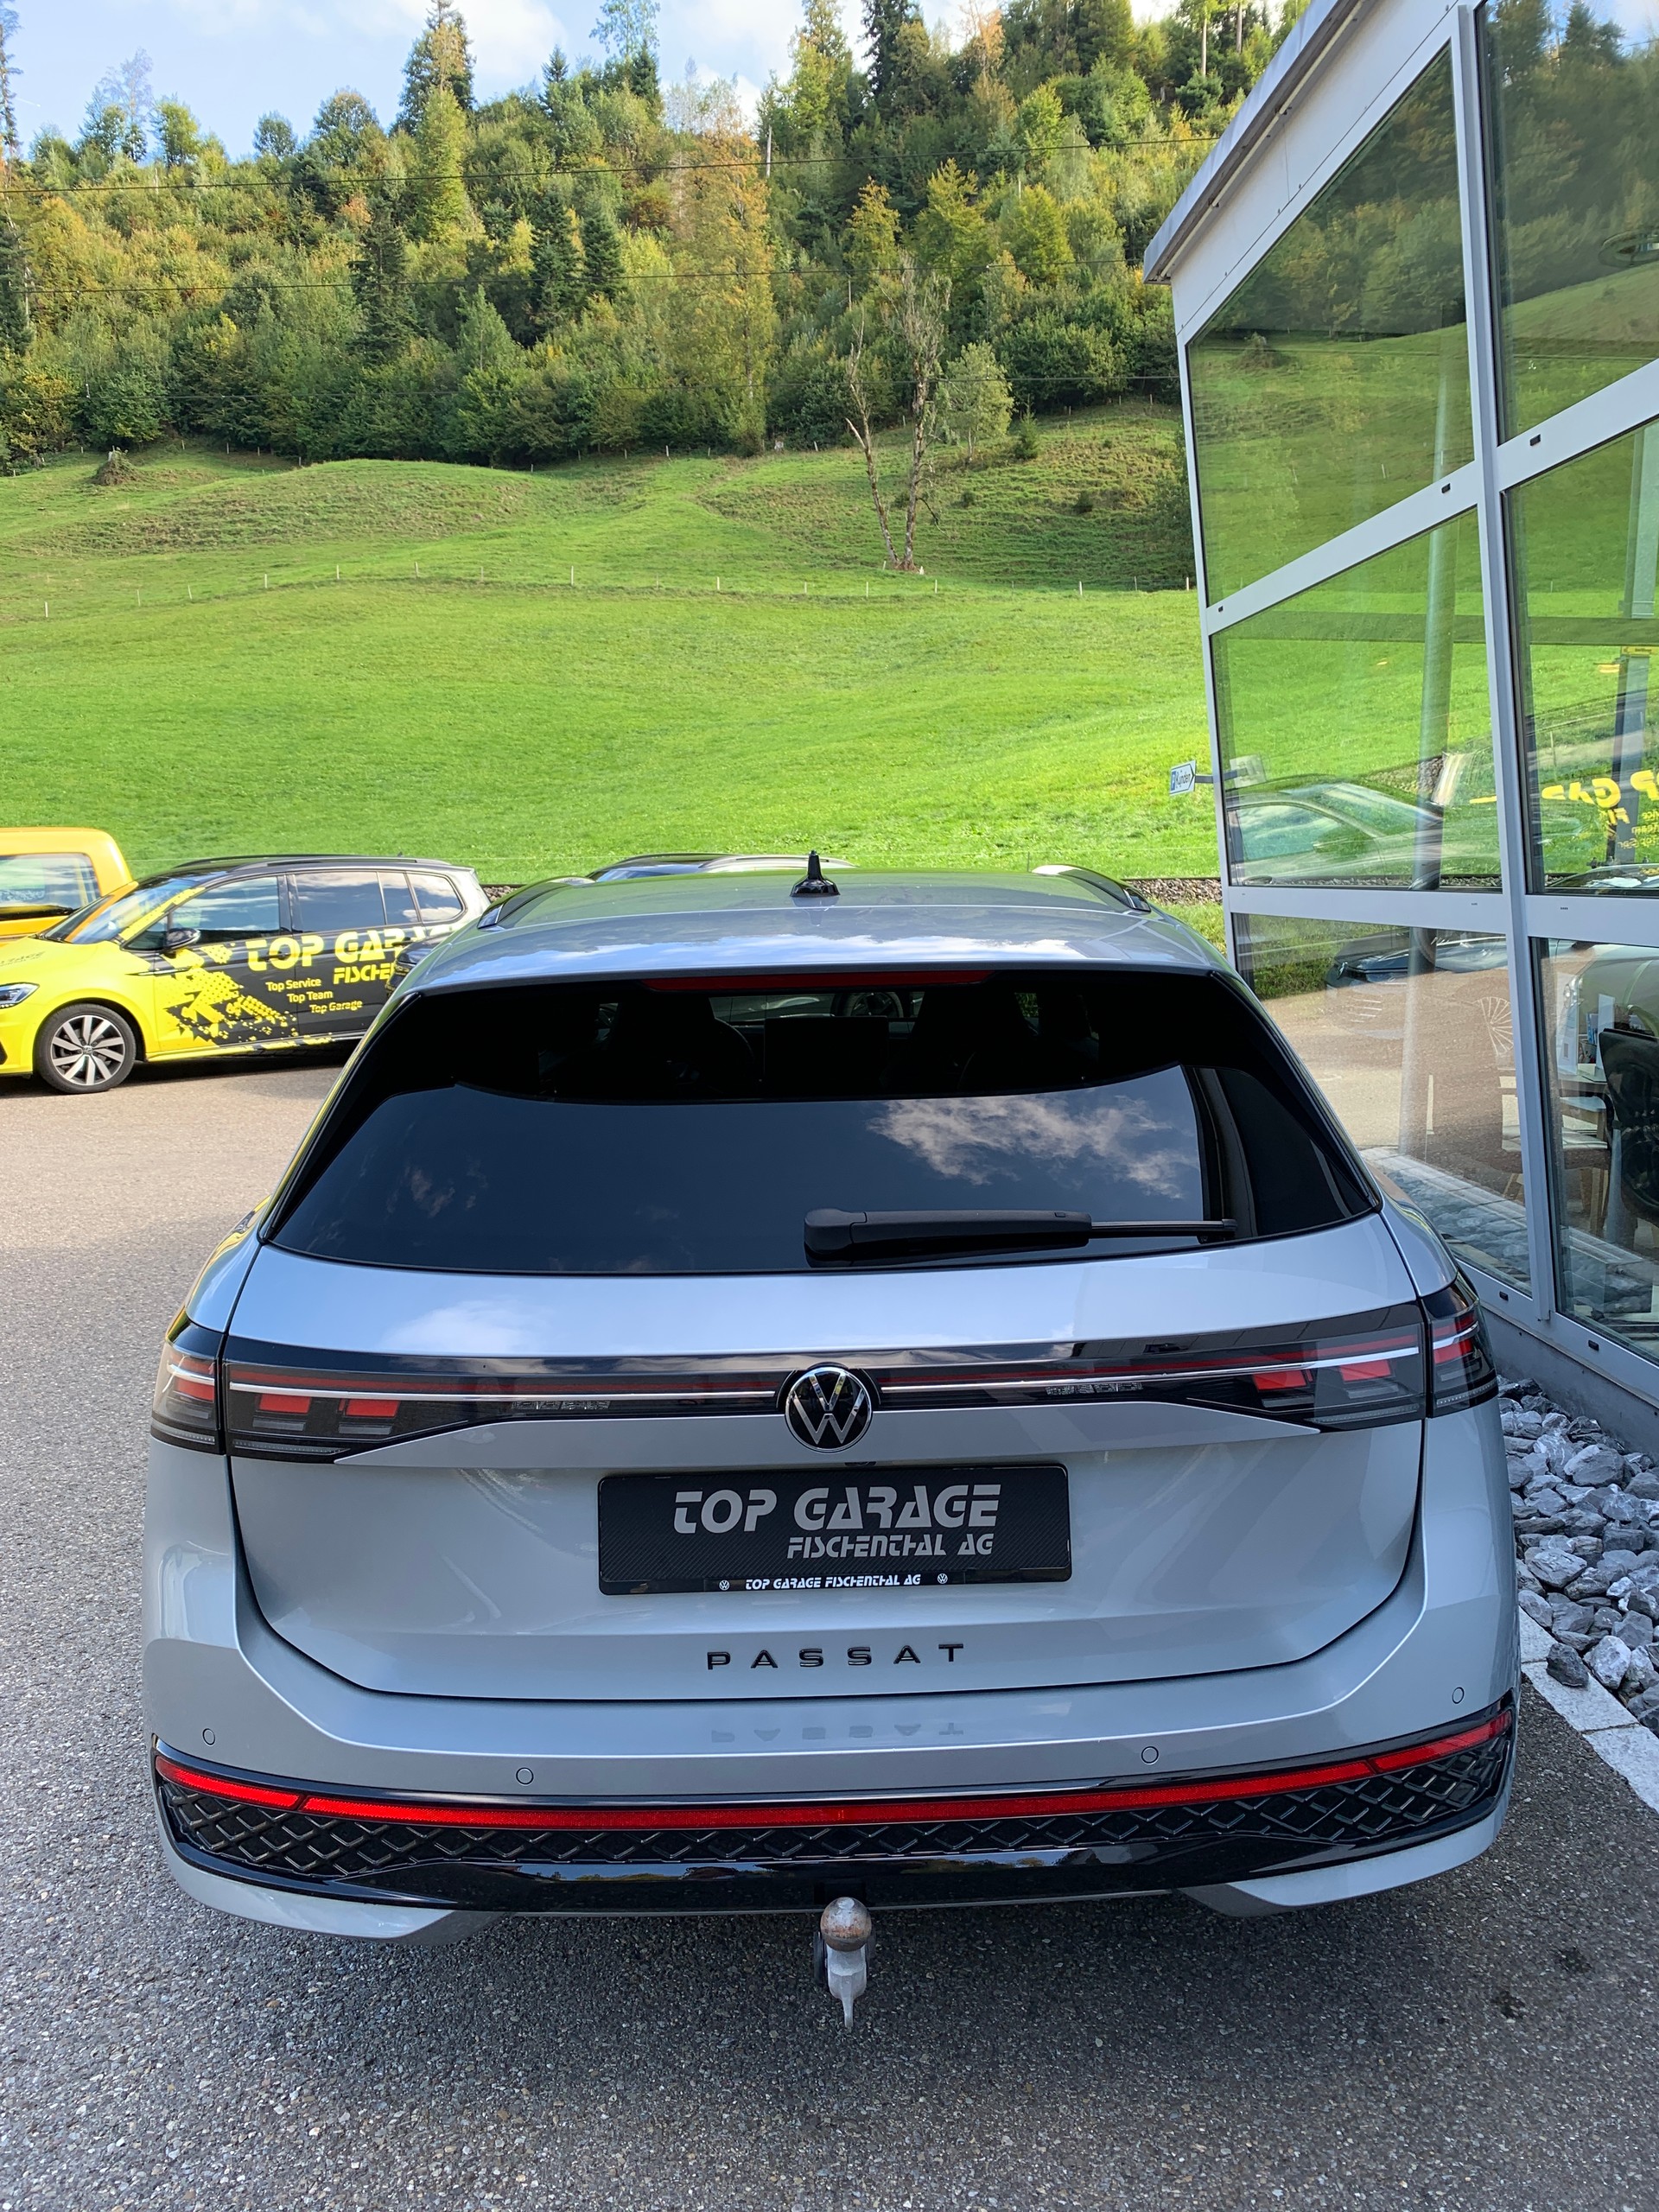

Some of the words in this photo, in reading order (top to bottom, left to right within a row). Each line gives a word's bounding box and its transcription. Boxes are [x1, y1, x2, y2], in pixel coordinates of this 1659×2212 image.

[245, 935, 325, 971] TOP
[265, 981, 285, 993] Top
[286, 977, 322, 990] Service
[333, 963, 395, 985] FISCHE
[286, 993, 306, 1004] Top
[306, 990, 334, 1001] Team
[309, 1003, 327, 1014] Top
[328, 1000, 363, 1013] Garage
[674, 1489, 777, 1534] TOP
[793, 1484, 1001, 1531] GARAGE
[786, 1535, 947, 1559] FISCHENTHAL
[957, 1533, 995, 1555] AG
[746, 1580, 771, 1590] TOP
[773, 1578, 822, 1589] GARAGE
[824, 1575, 900, 1588] FISCHENTHAL
[903, 1574, 921, 1586] AG
[707, 1643, 964, 1670] PASSAT
